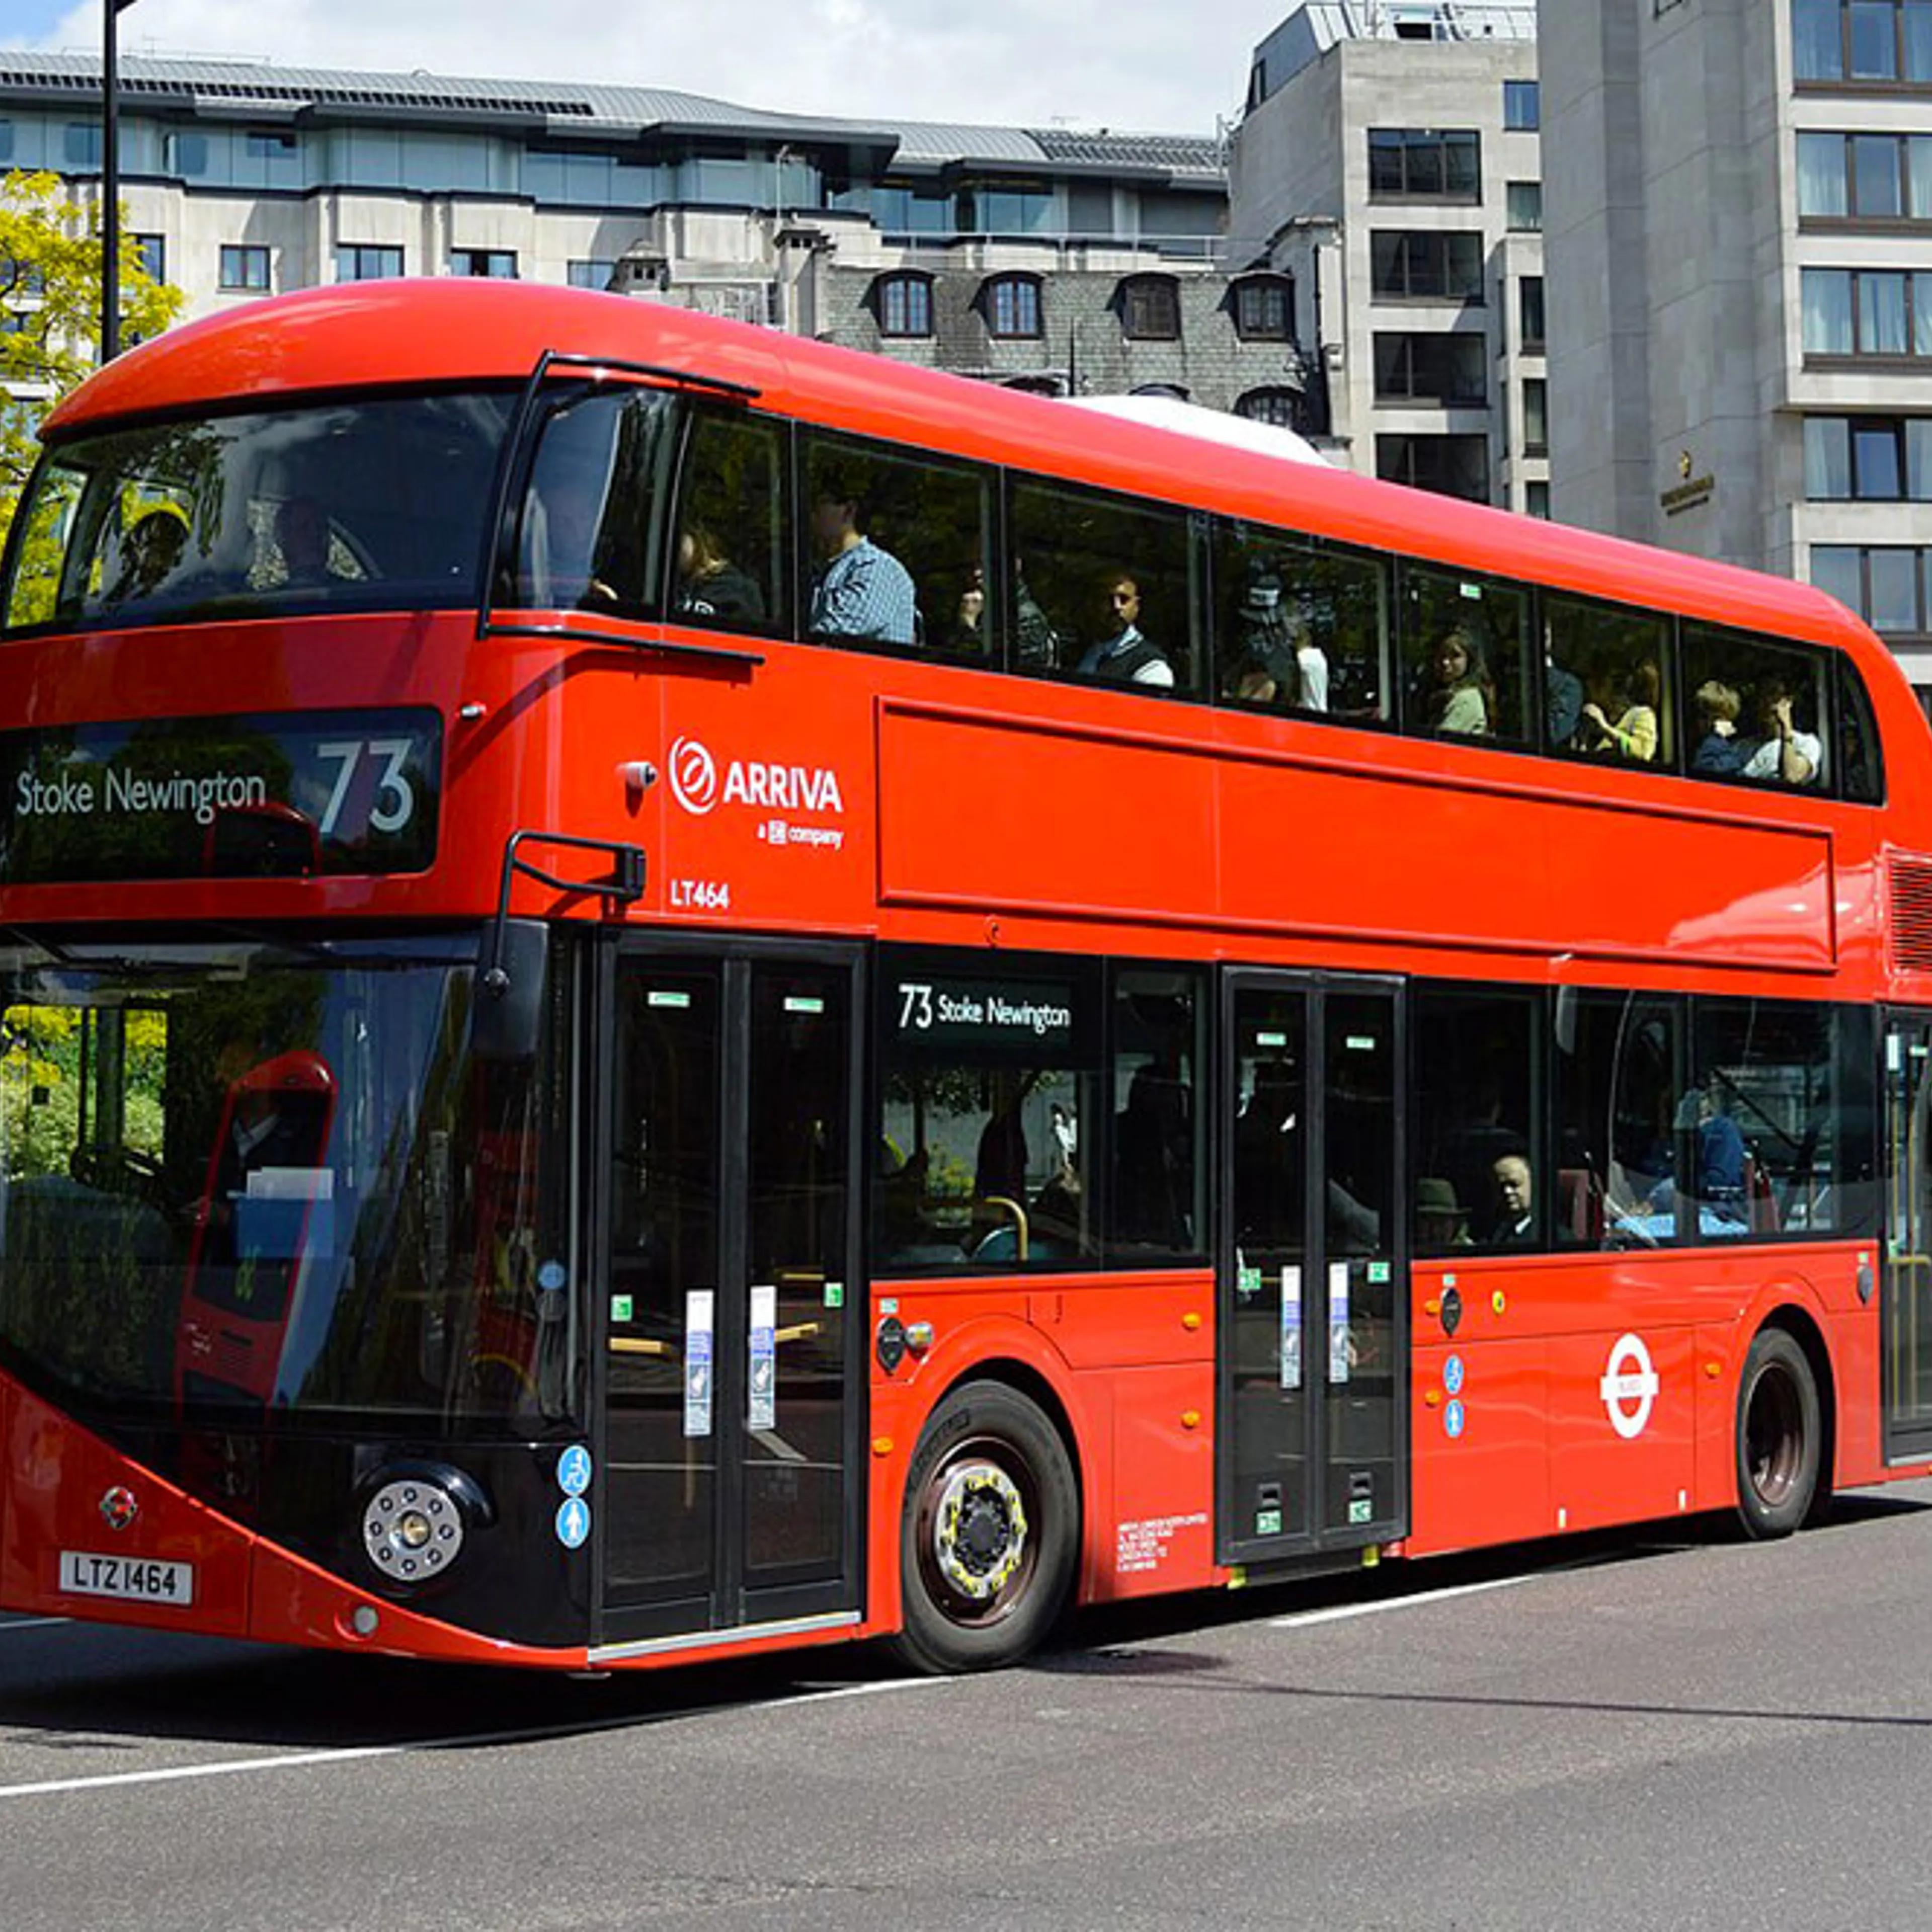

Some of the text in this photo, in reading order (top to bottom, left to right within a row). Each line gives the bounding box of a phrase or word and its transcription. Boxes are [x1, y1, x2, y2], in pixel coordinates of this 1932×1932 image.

[16, 768, 266, 825] Stoke Newington
[316, 738, 414, 833] 73
[723, 761, 843, 812] ARRIVA
[671, 879, 730, 909] LT464
[899, 983, 1071, 1034] 73 Stoke Newington
